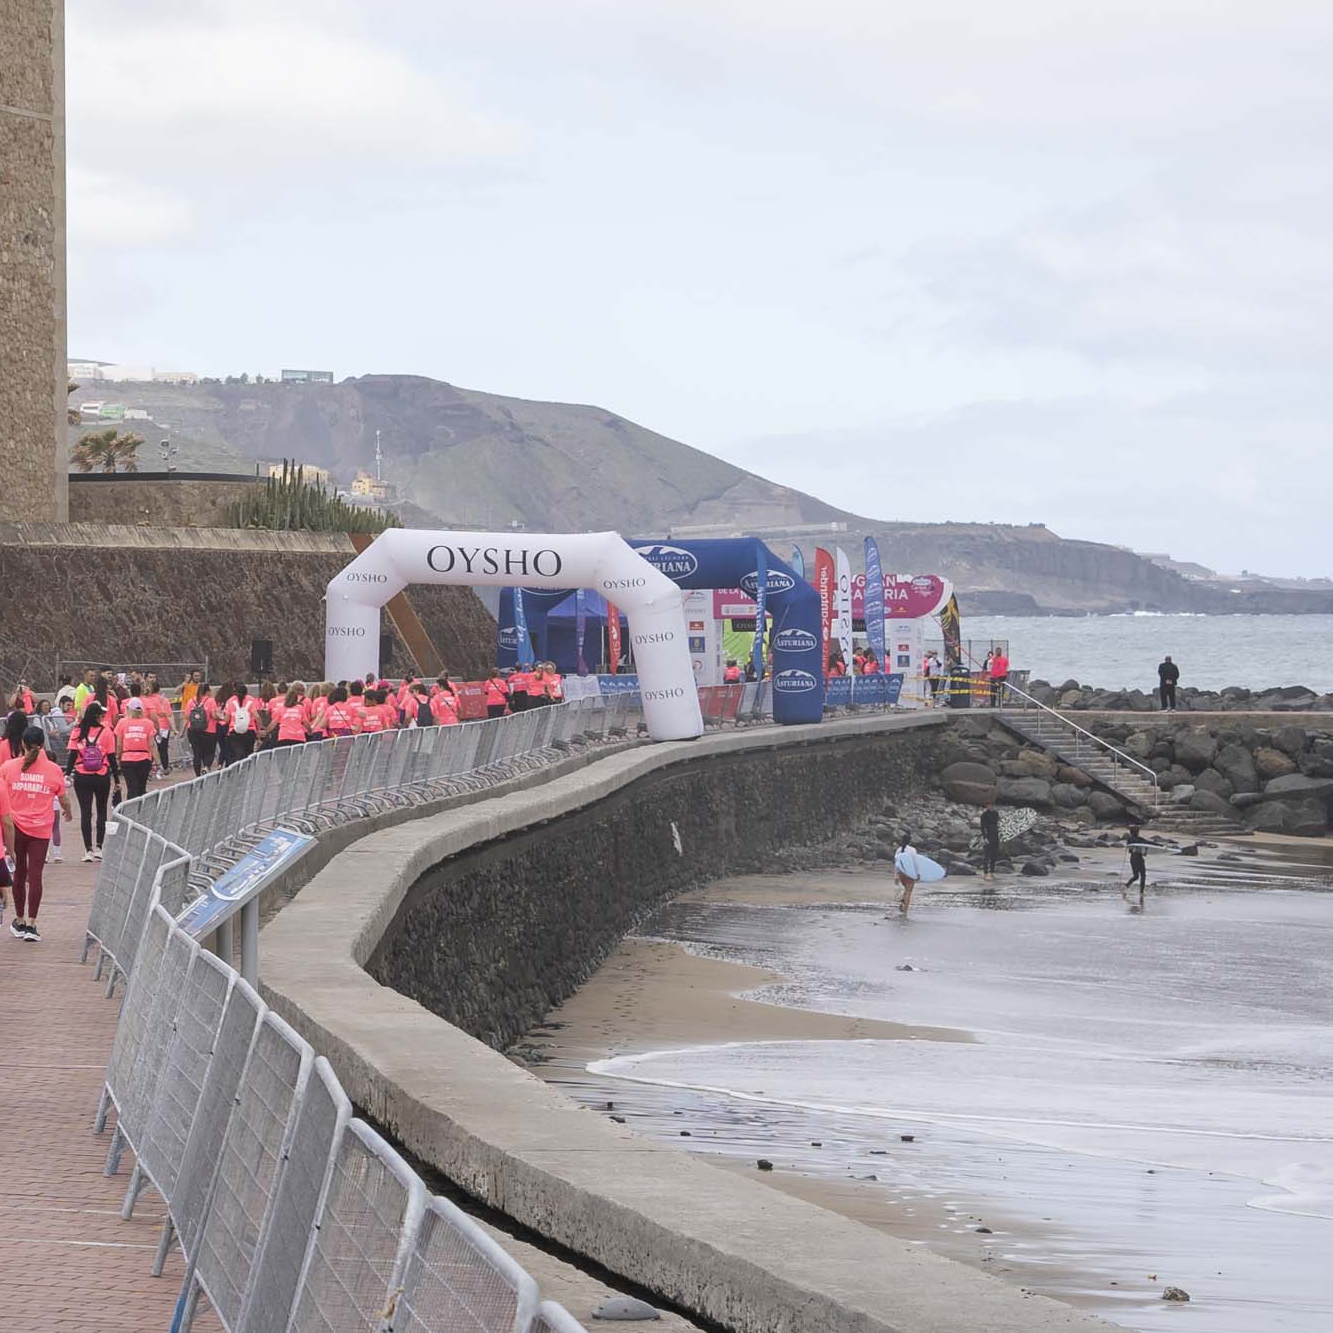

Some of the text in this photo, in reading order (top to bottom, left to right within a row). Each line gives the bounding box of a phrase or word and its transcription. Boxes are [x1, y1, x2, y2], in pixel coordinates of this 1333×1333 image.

[427, 545, 562, 577] OYSHO
[649, 561, 691, 573] RIANA
[346, 572, 387, 583] OYSHO
[603, 577, 646, 589] OYSHO
[744, 579, 790, 588] ASTIANA
[856, 575, 897, 587] GN
[851, 589, 909, 600] ARIA
[328, 625, 365, 637] OYSHO
[636, 631, 674, 644] OYSHO
[776, 637, 814, 647] ASTURIANA
[776, 678, 814, 687] ASTURIANA
[645, 686, 684, 700] OYSHO
[20, 772, 44, 783] SOMOS
